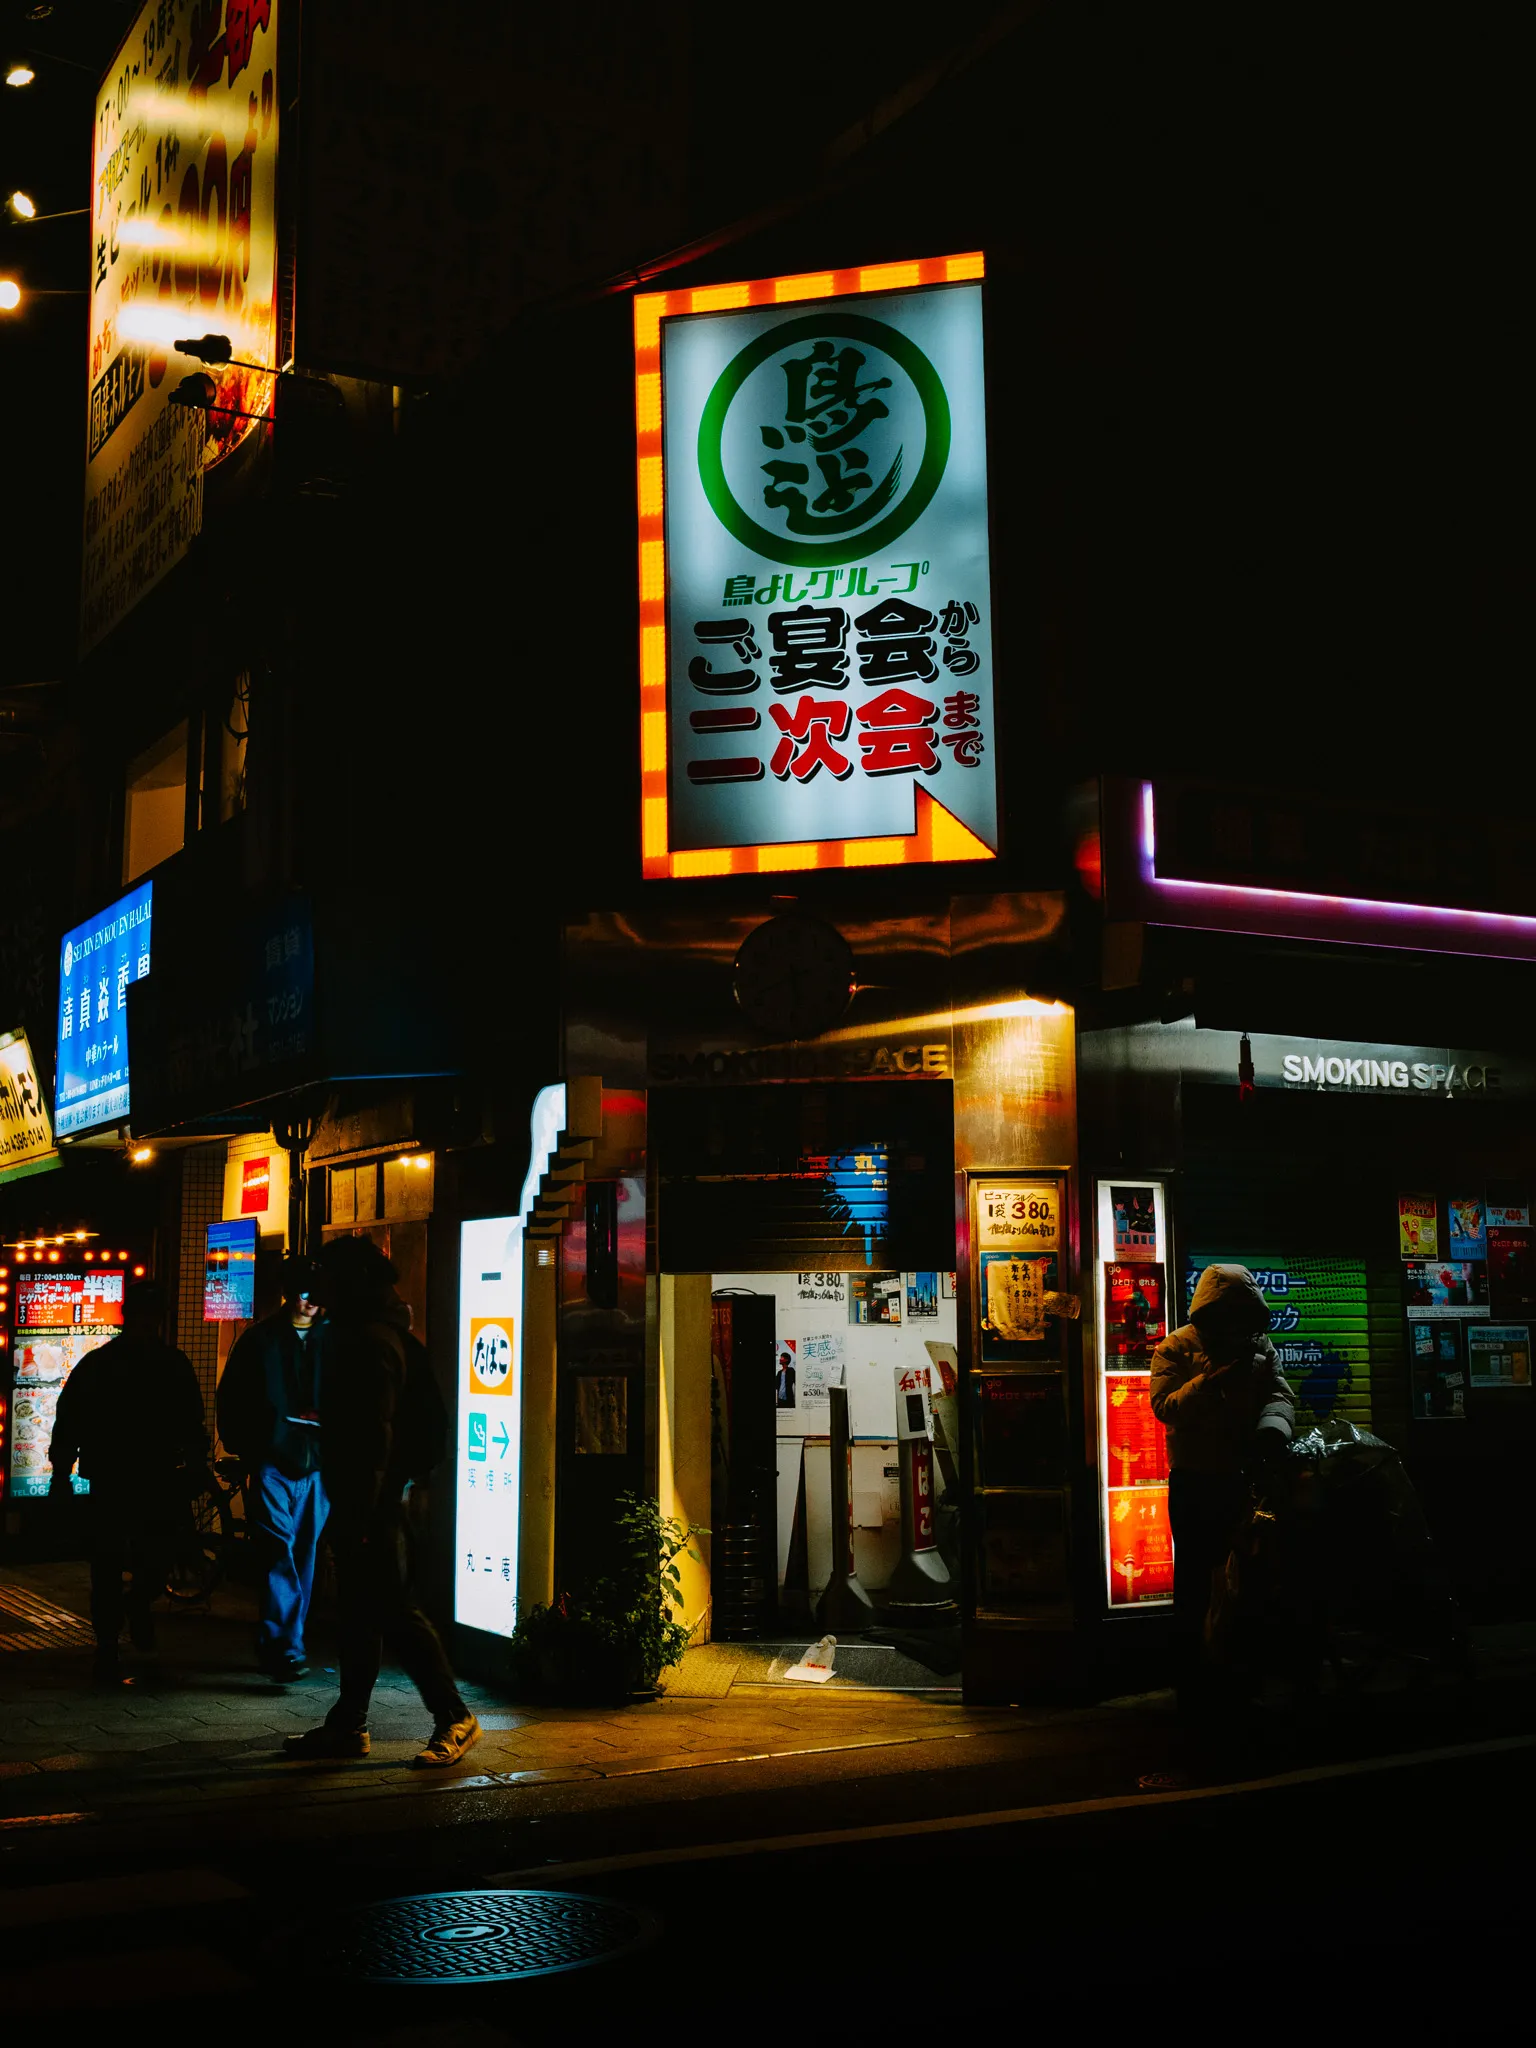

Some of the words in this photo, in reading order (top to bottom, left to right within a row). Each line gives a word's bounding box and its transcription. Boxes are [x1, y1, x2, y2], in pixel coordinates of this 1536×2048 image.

[722, 568, 930, 608] 鳥よしグループ
[688, 597, 981, 696] ご宴会から
[686, 688, 986, 785] 二次会まで
[72, 942, 83, 963] SEI
[83, 936, 95, 958] XIN
[119, 918, 129, 941] EN
[1283, 1054, 1409, 1089] SMOKING
[1411, 1062, 1501, 1092] SPACE
[83, 1275, 123, 1303] 半額
[1108, 1263, 1121, 1275] glo
[473, 1335, 509, 1376] たばこ
